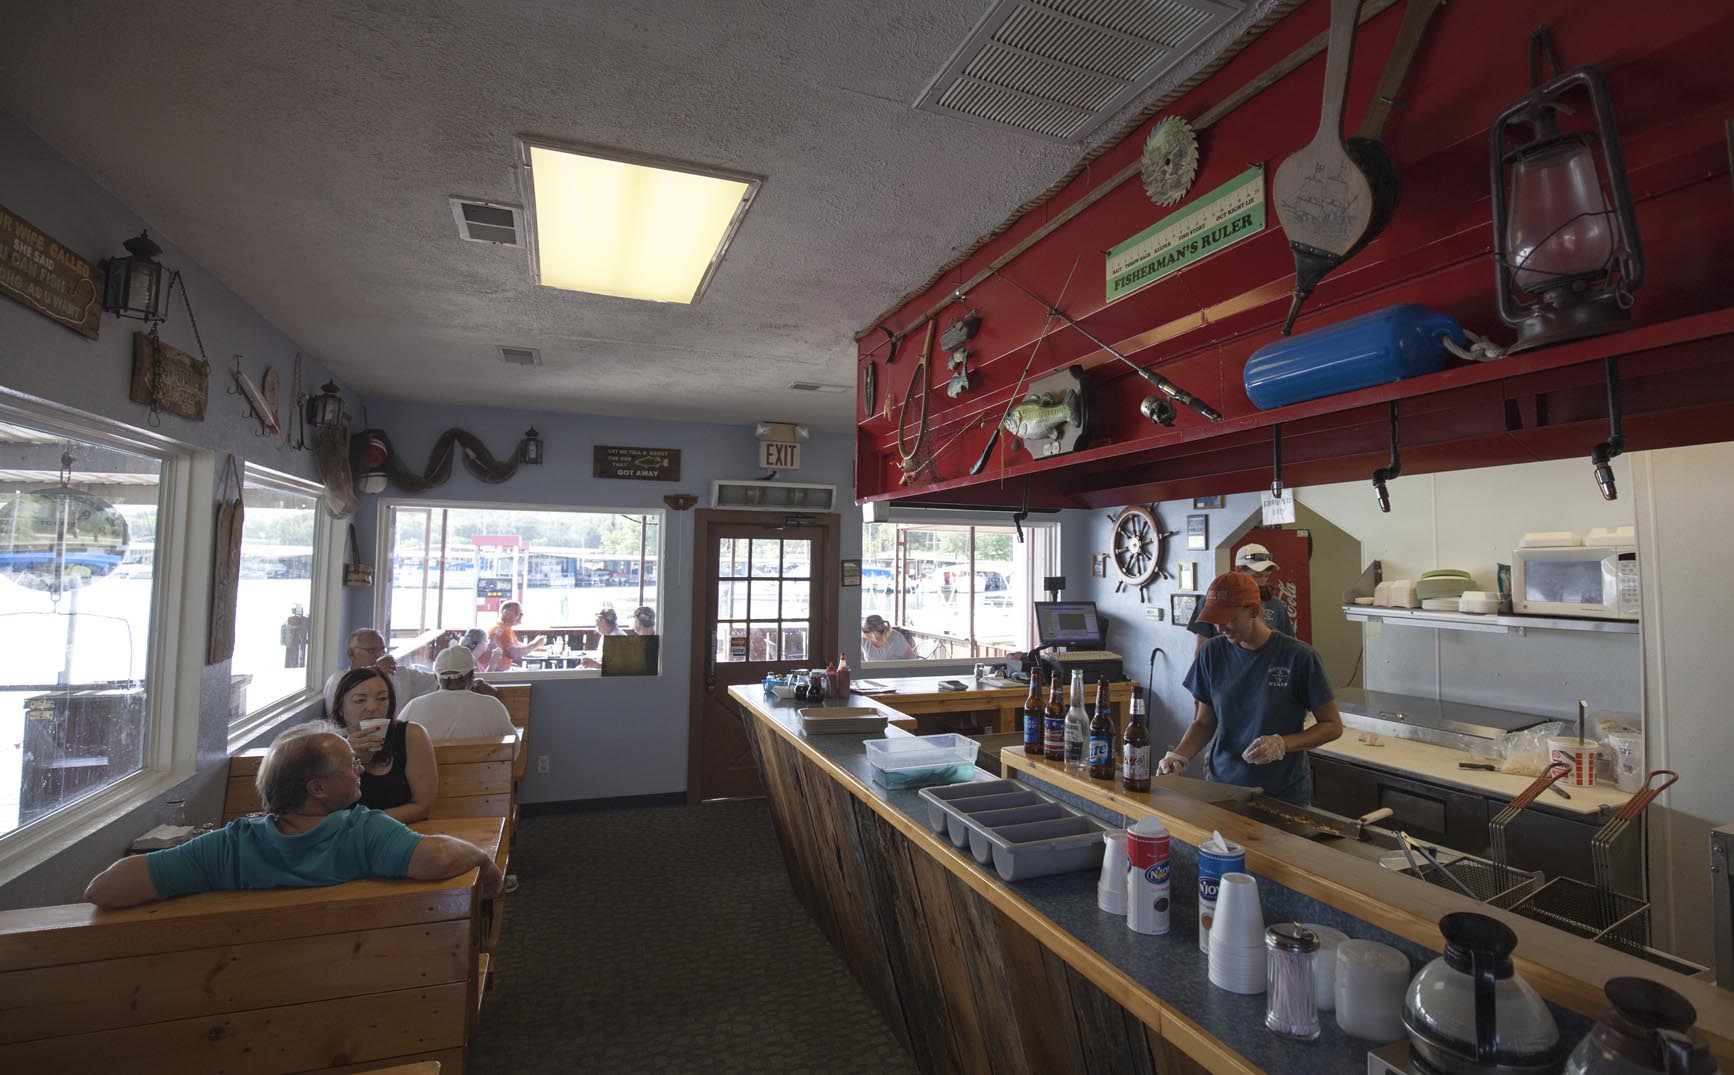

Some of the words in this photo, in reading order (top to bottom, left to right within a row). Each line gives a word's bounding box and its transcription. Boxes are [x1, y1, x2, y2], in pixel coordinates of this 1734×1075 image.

[13, 238, 33, 257] SHE
[33, 251, 55, 270] SAID
[15, 221, 46, 250] WIFE
[49, 242, 91, 278] CALLED
[1114, 240, 1200, 291] FISHERMAN'S
[1202, 213, 1253, 249] RULER
[1154, 241, 1172, 254] KEEPER
[11, 252, 38, 278] CAN
[53, 296, 82, 320] WANT
[767, 443, 797, 466] EXIT
